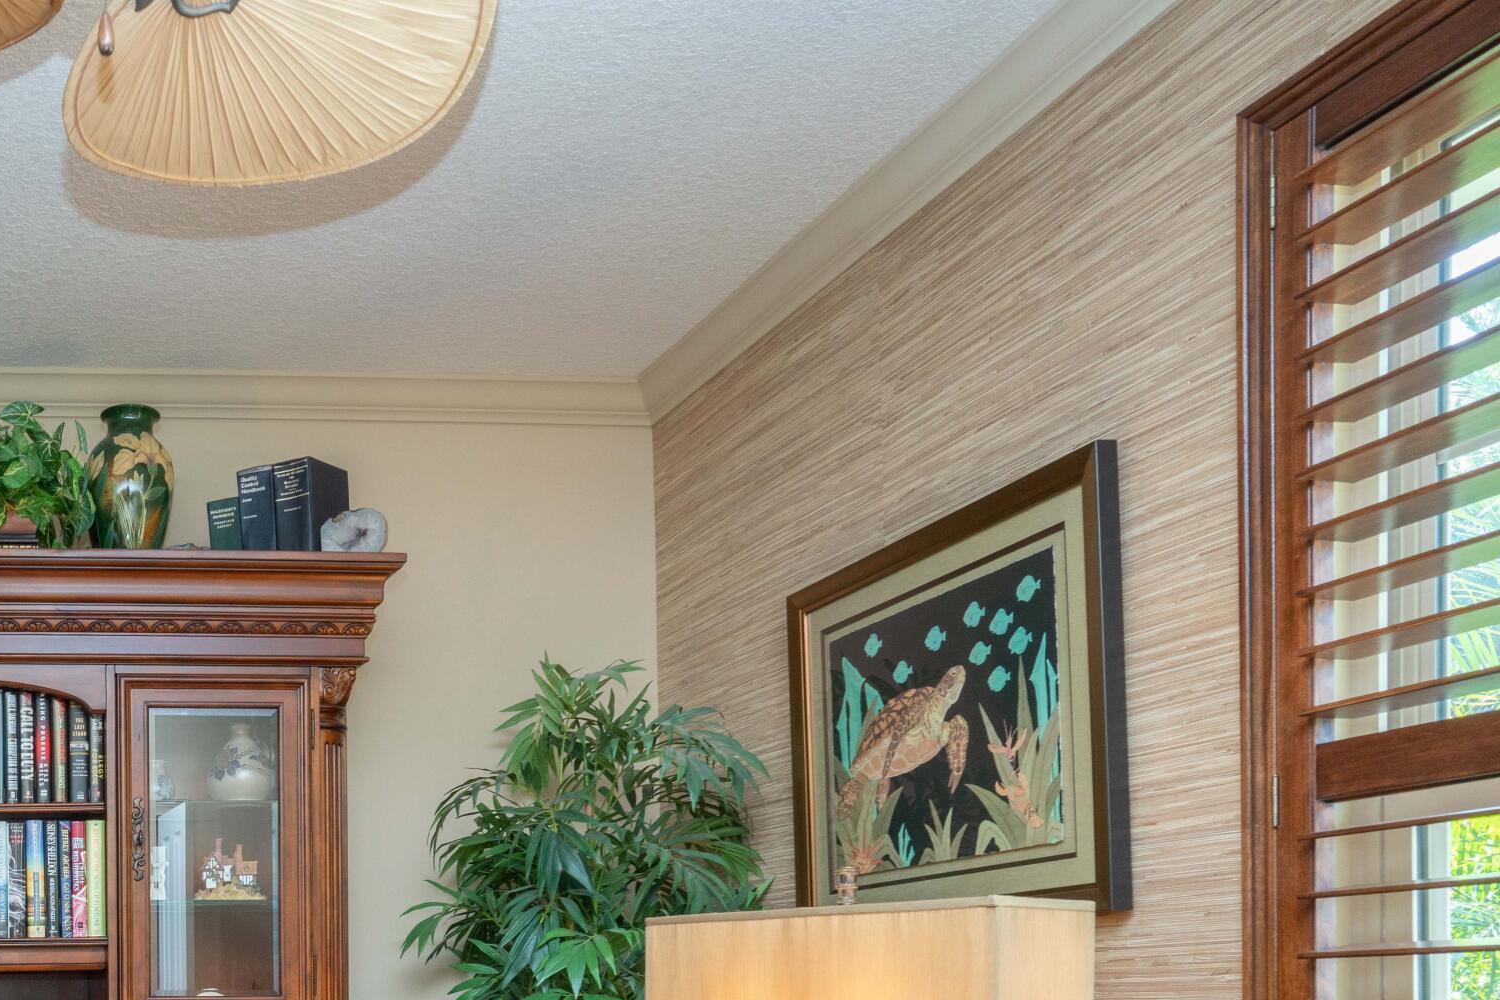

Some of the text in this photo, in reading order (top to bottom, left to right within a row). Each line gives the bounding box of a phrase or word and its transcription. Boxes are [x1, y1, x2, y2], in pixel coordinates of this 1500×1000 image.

[20, 707, 34, 781] CALL TO DUTY
[46, 823, 57, 877] SIDNEY SHELDON
[62, 829, 71, 880] JEFFREY ARCHER
